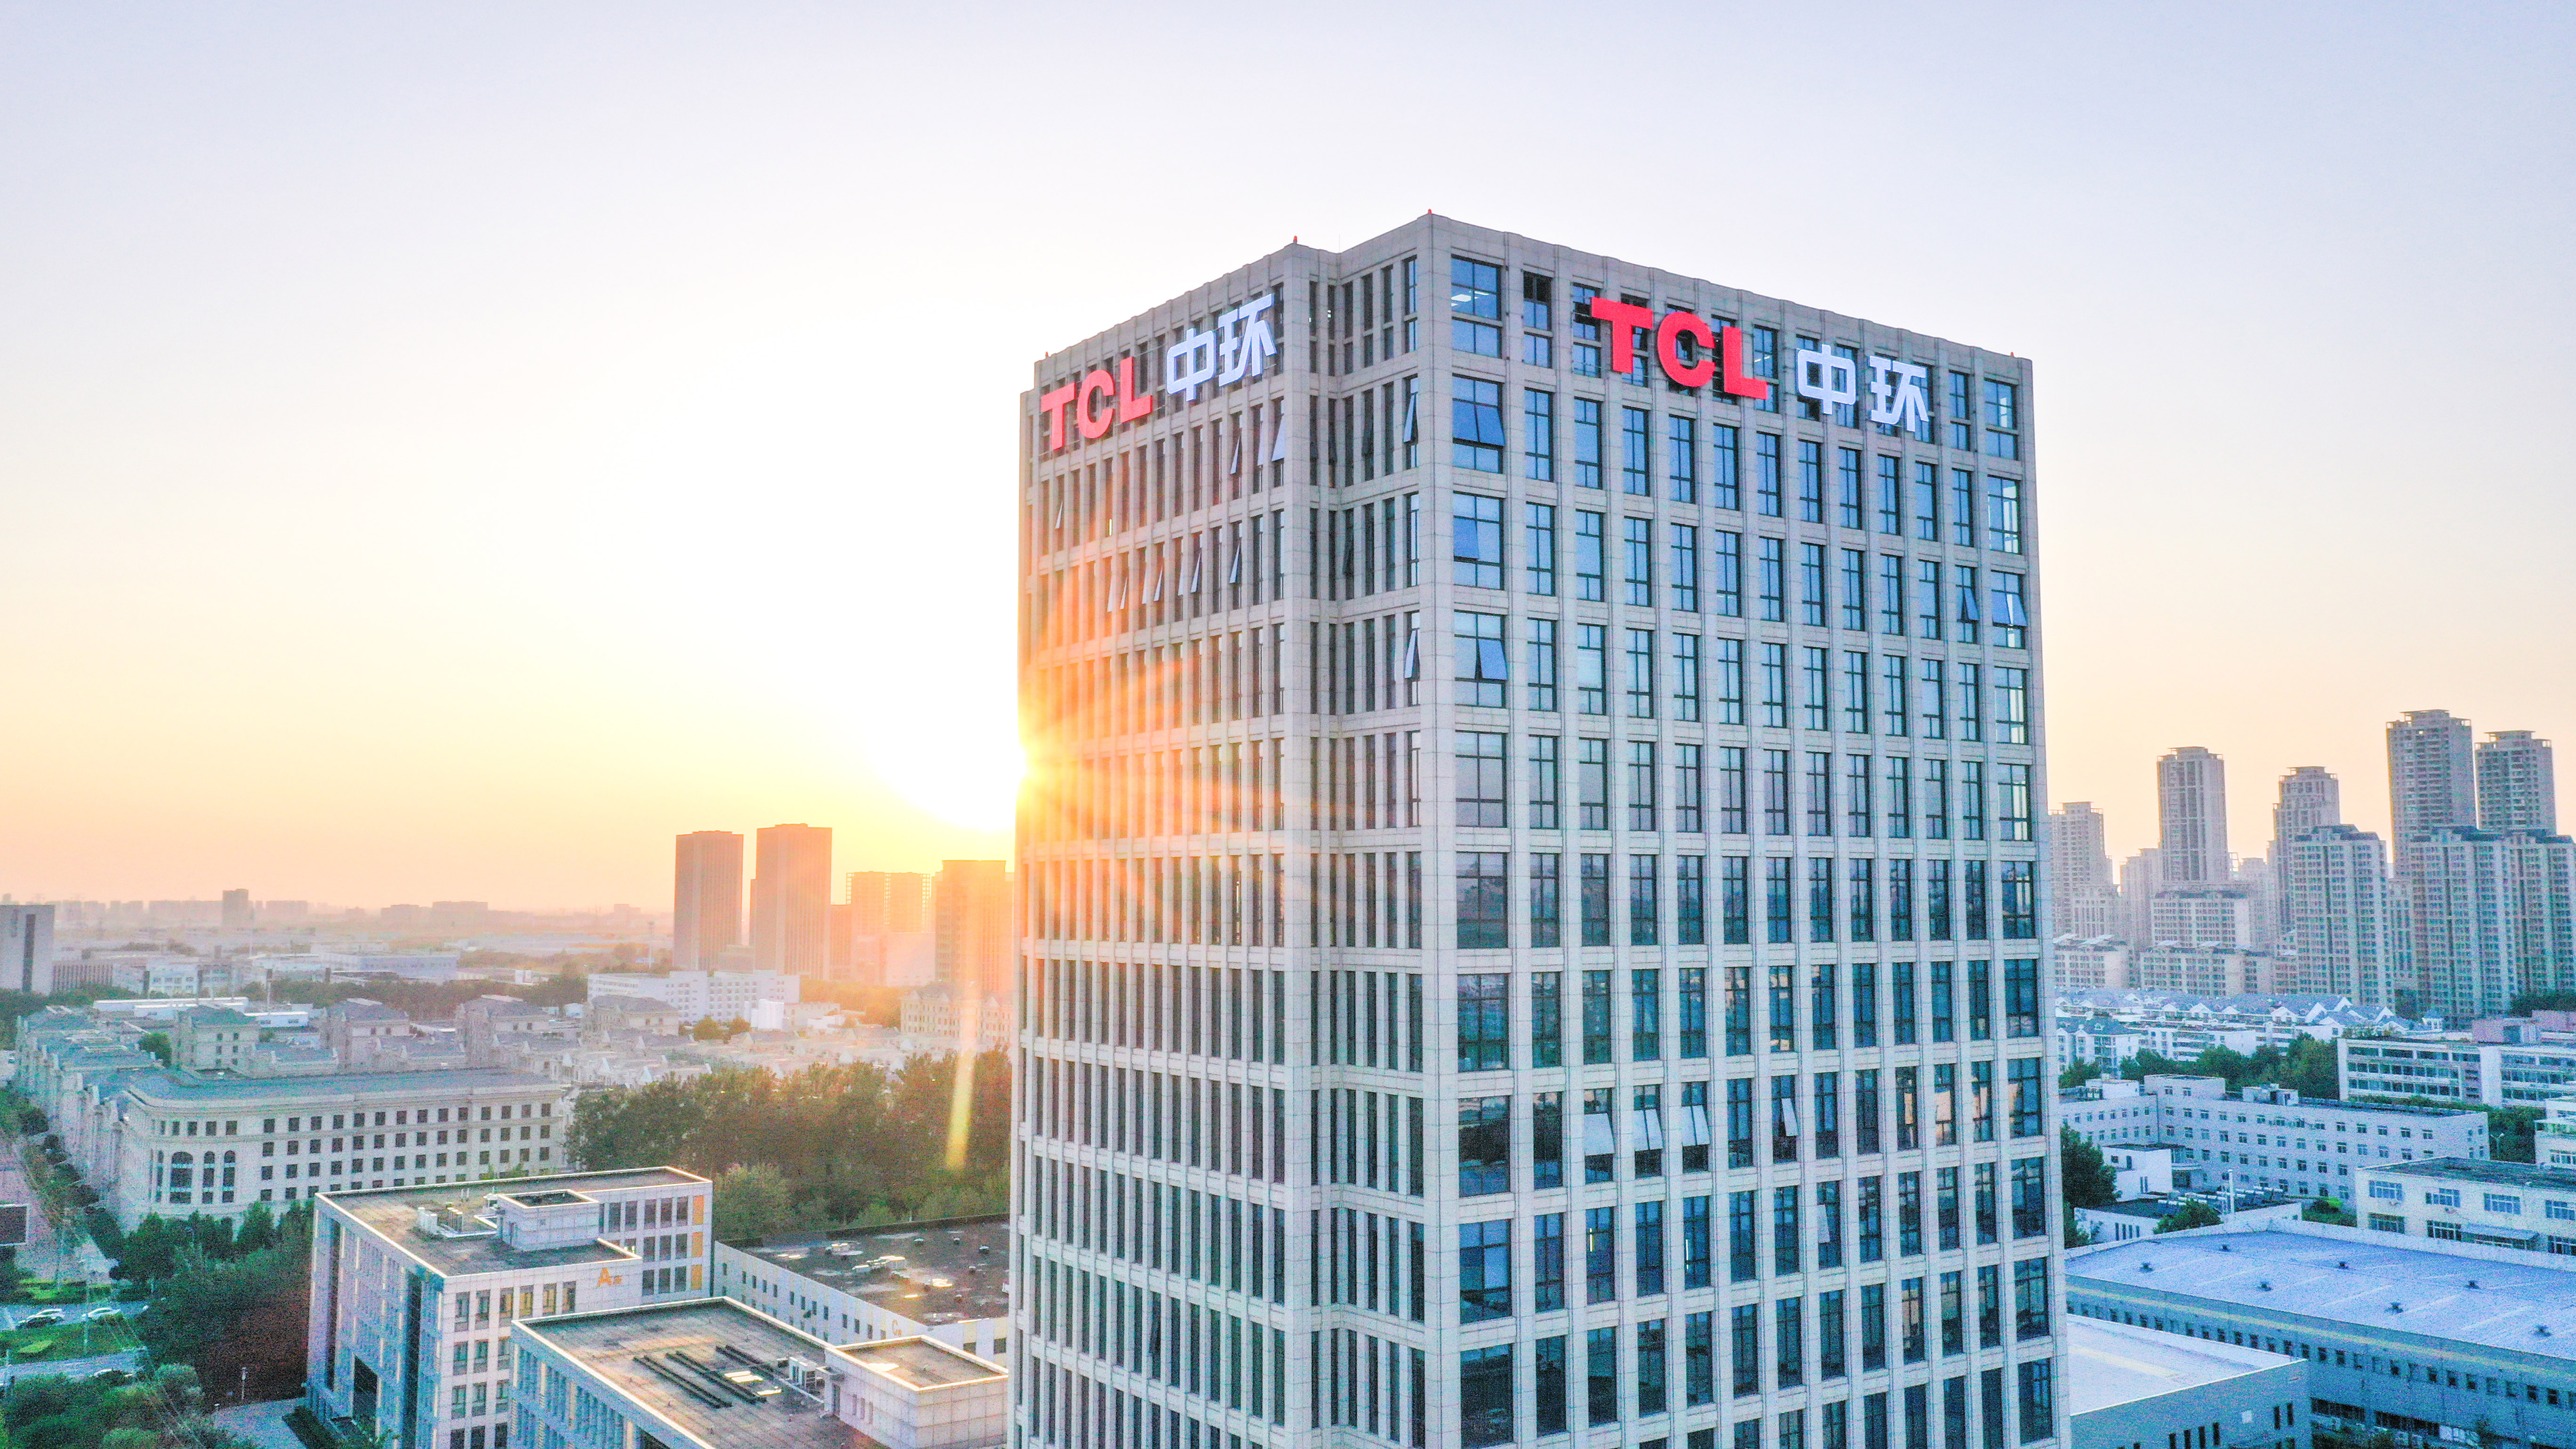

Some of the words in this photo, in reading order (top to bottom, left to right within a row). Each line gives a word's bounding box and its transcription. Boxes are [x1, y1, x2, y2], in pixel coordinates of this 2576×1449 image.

[1041, 357, 1153, 451] TCL
[1166, 293, 1277, 402] 中环
[1591, 297, 1768, 400] TCL
[1796, 344, 1929, 432] 中环
